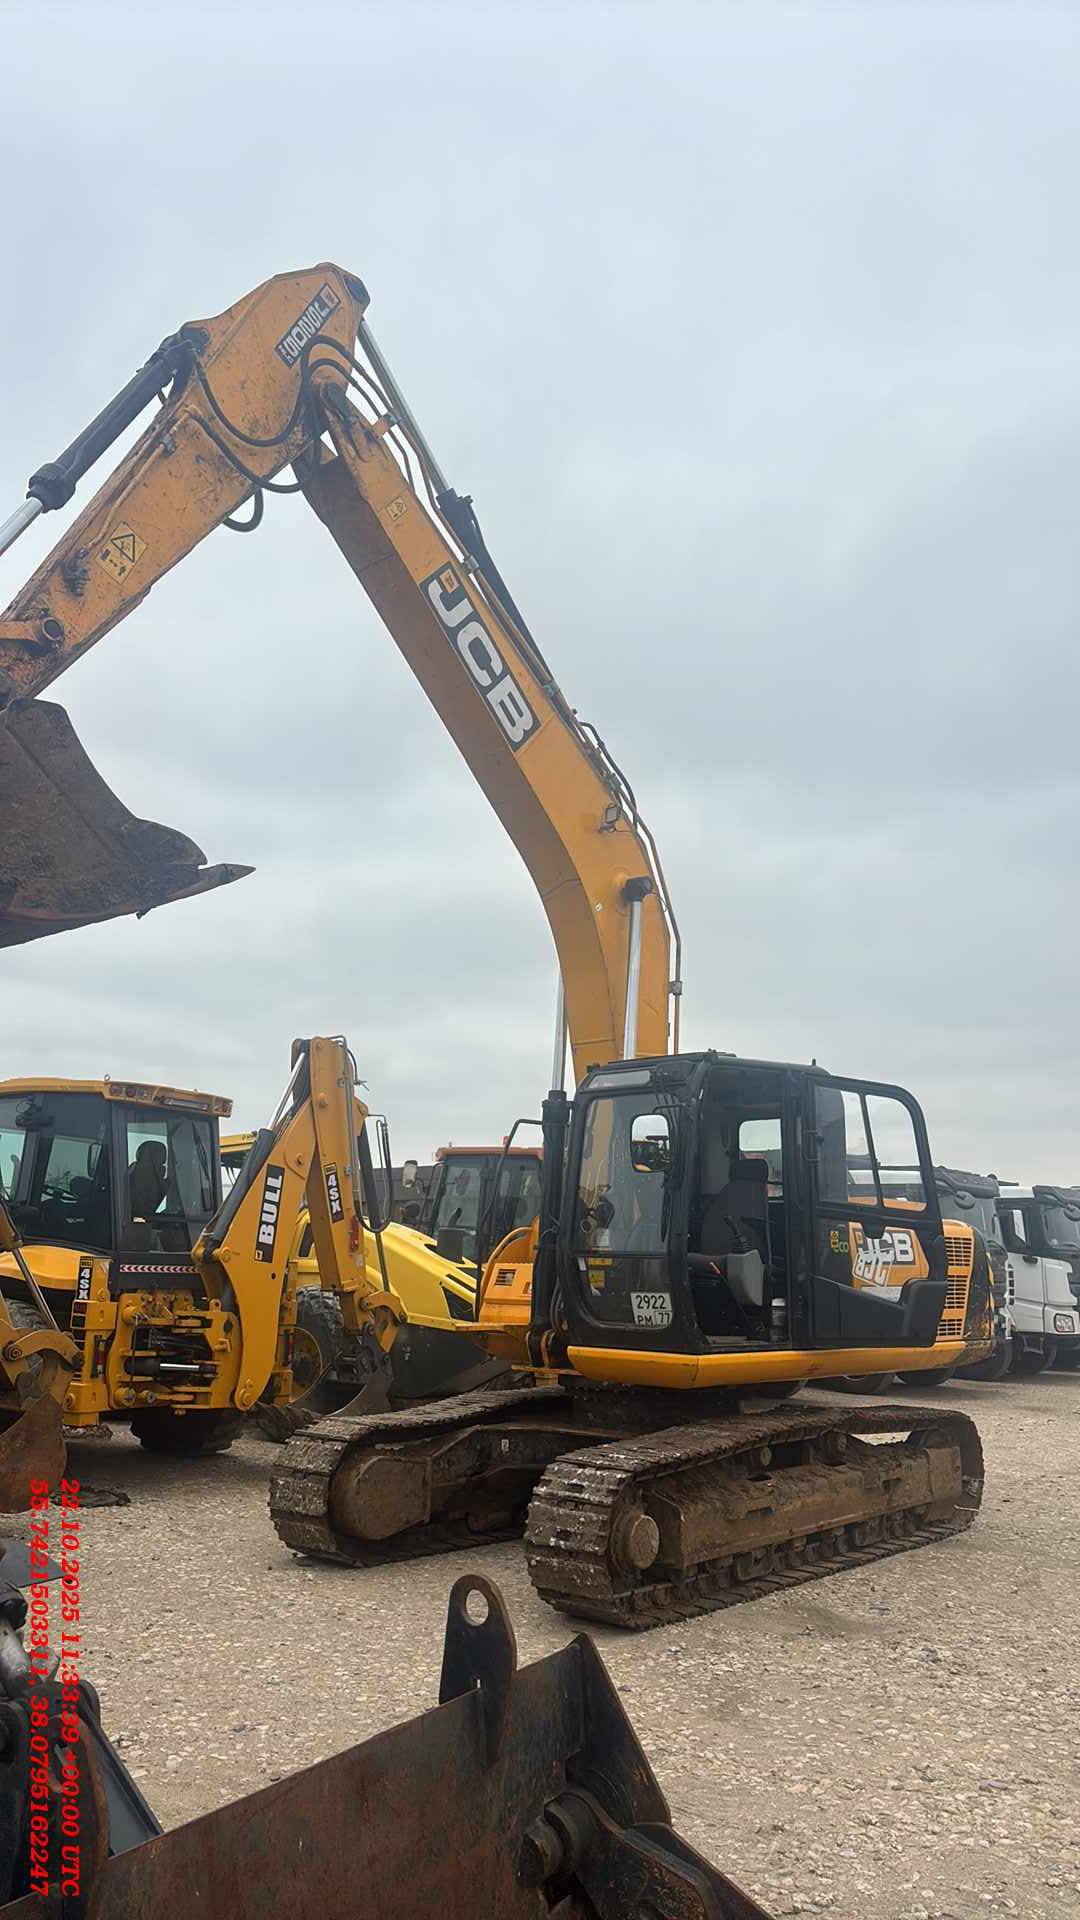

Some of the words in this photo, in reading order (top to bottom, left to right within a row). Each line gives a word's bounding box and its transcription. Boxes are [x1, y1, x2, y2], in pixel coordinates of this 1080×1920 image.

[428, 580, 533, 742] JCB
[258, 1175, 282, 1245] BULL
[328, 1174, 342, 1214] 4SX
[78, 1268, 90, 1300] 4SX
[635, 1294, 667, 1310] 2922
[658, 1312, 670, 1323] 77
